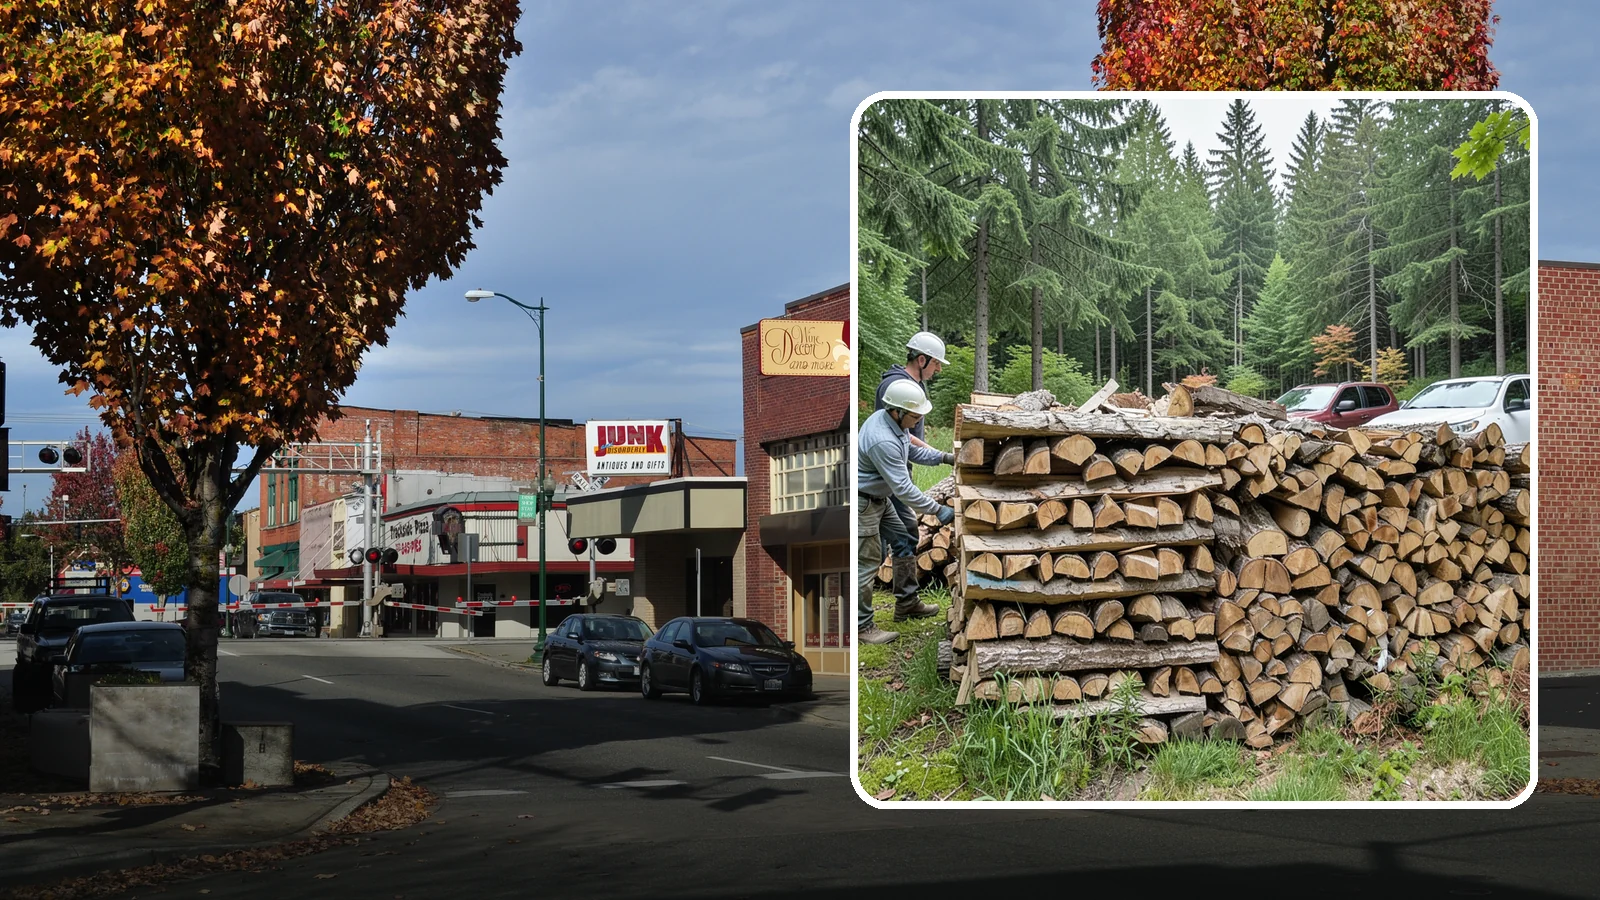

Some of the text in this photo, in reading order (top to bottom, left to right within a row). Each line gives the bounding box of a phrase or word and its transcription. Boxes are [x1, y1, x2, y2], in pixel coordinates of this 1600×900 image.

[595, 425, 665, 457] JUNK
[607, 446, 646, 454] DISORDERLY
[597, 460, 665, 470] ANTIQUES AND GIFTS
[414, 519, 429, 535] Pizza
